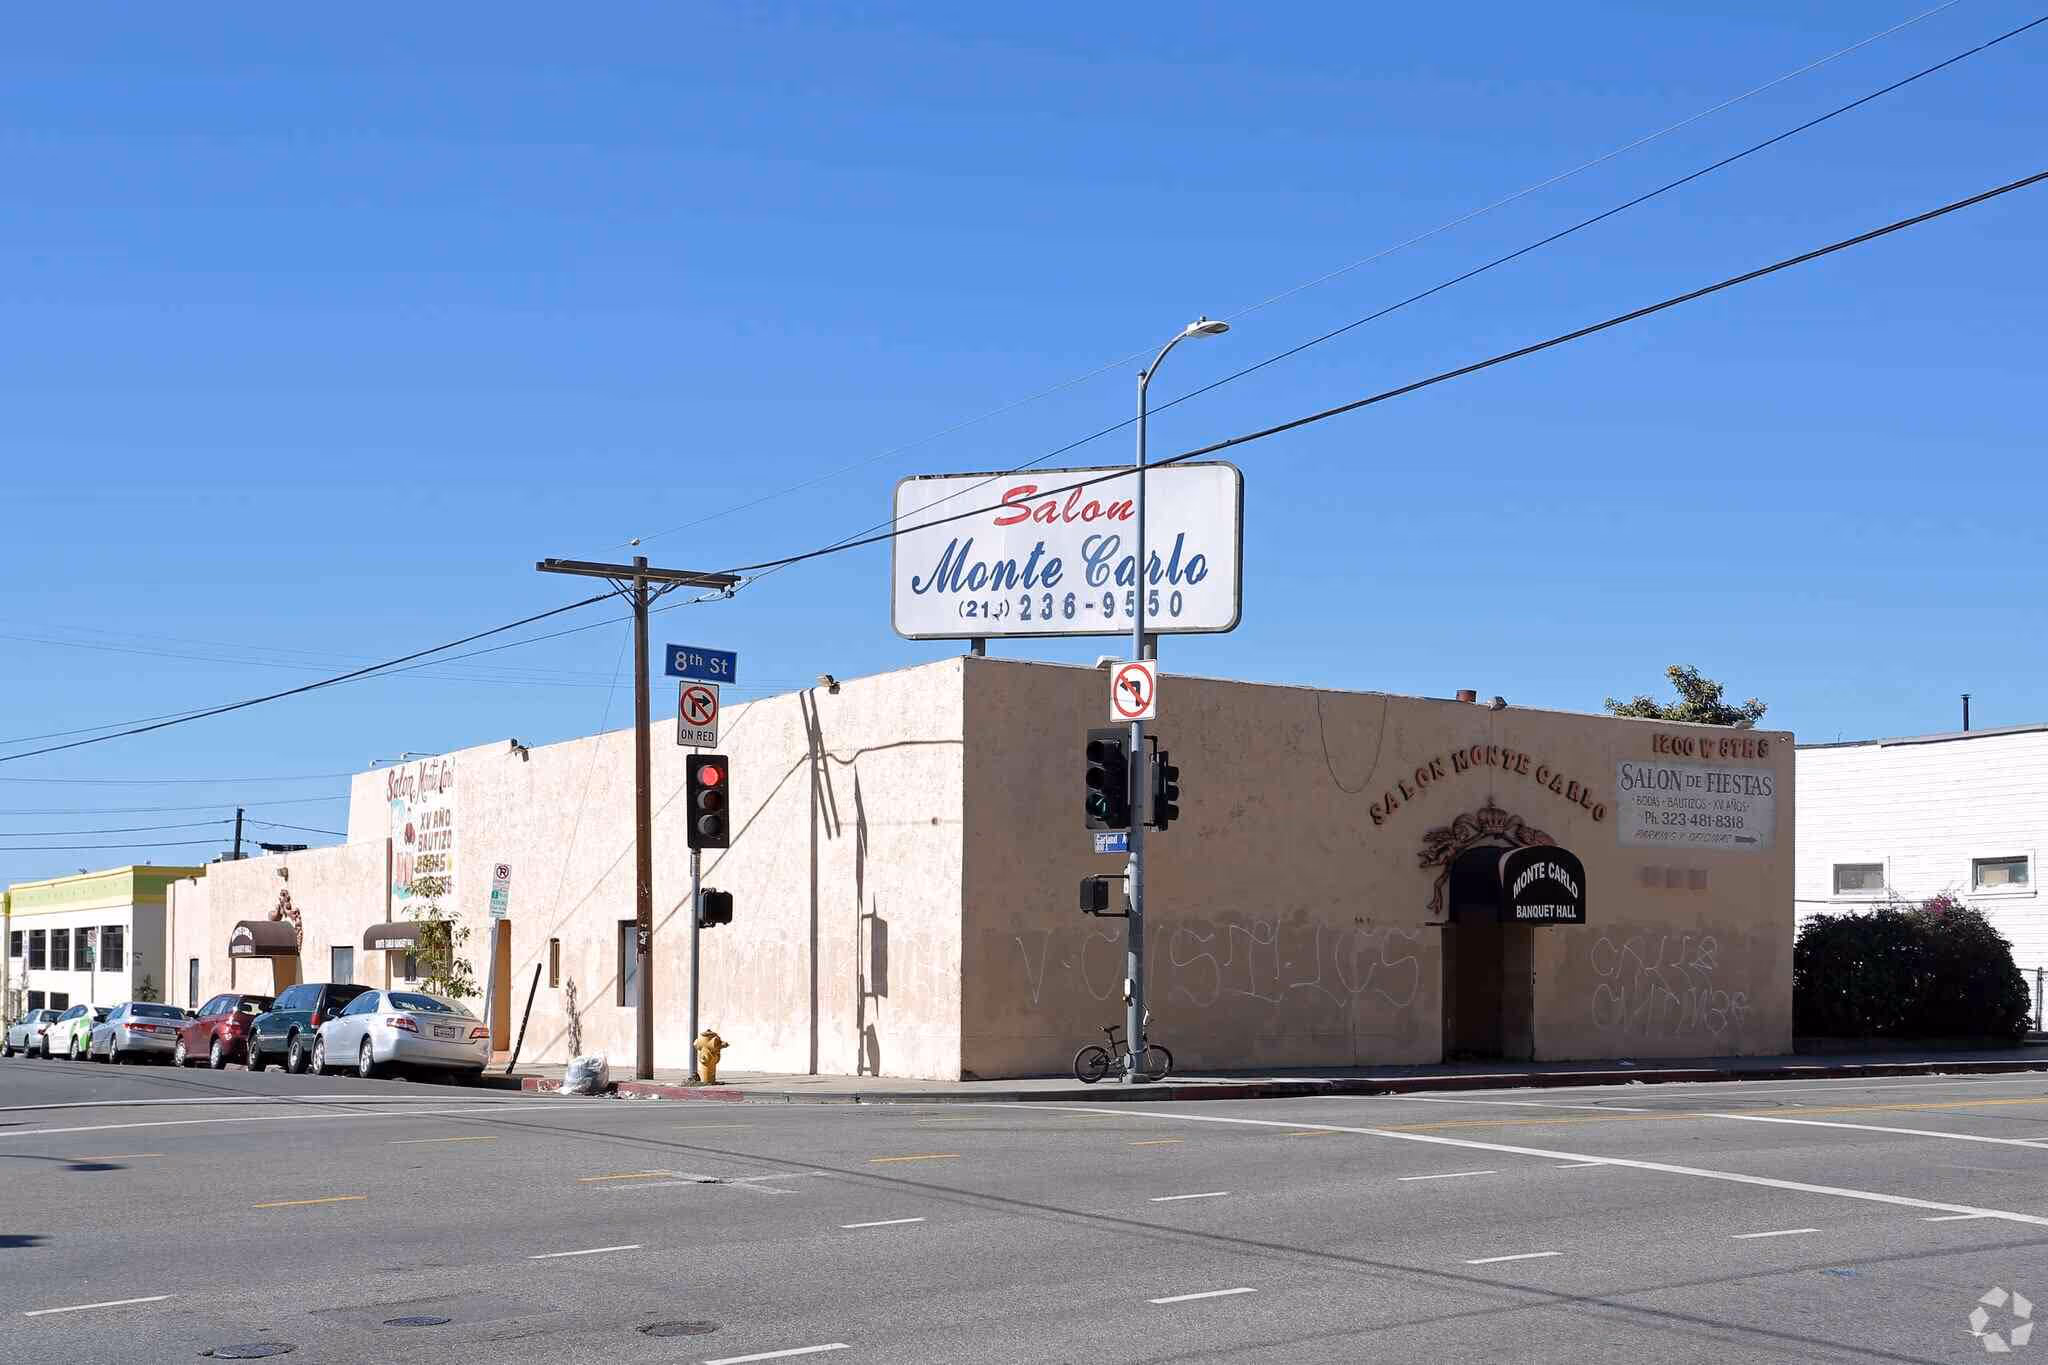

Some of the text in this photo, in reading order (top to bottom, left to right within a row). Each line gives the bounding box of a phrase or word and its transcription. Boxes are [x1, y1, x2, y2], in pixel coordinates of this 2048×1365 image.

[993, 484, 1135, 526] Salon
[912, 532, 1208, 595] Monte Carlo
[674, 651, 728, 674] 8th St
[681, 729, 714, 742] ON RED
[1652, 733, 1694, 756] 1200
[1699, 736, 1713, 759] W
[1369, 744, 1608, 825] SALON MONTE CARLO
[1620, 763, 1773, 797] SALON DE FIESTAS
[1513, 862, 1579, 899] MONTE CARLO
[1516, 905, 1576, 918] BANQUET HALL
